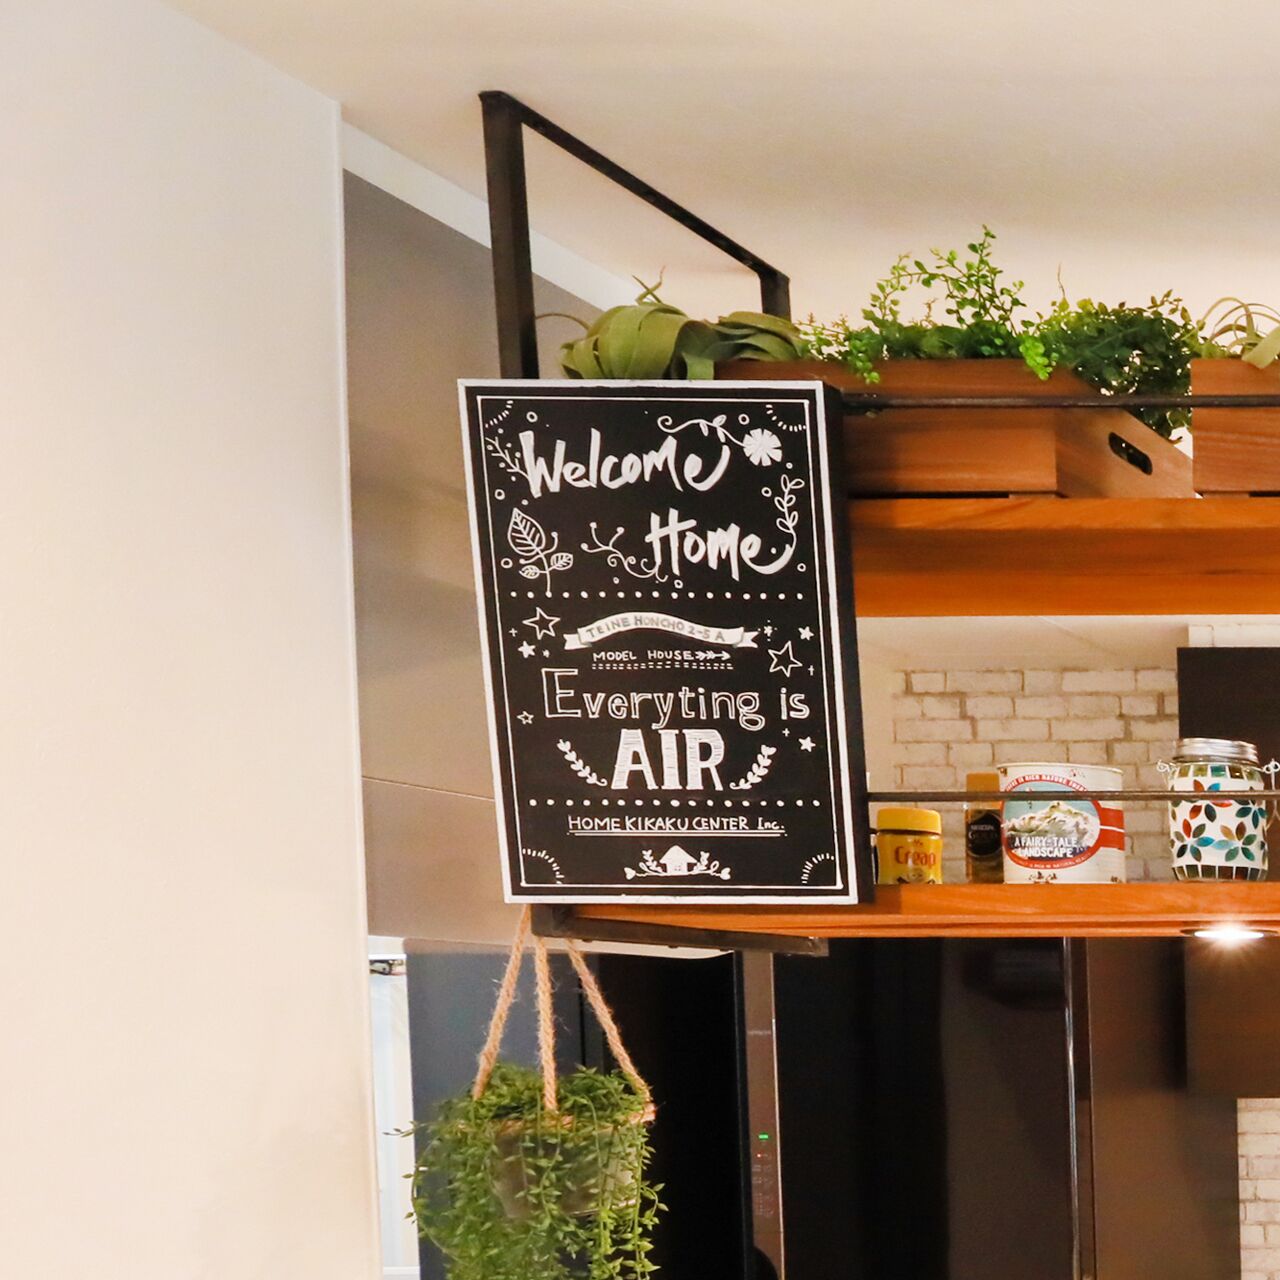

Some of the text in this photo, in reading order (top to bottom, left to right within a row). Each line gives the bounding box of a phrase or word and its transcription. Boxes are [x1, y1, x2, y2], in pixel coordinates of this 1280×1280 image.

[518, 426, 731, 499] Welcome
[645, 507, 790, 581] Home
[586, 617, 630, 638] TEINE
[634, 615, 685, 631] HONCHO
[592, 650, 695, 662] MODEL HOUSE
[541, 667, 811, 730] Everyting is
[610, 729, 725, 791] AIR
[567, 815, 785, 831] HOME KIKAKU CENTER Inc.
[895, 845, 936, 869] Creap
[1019, 846, 1074, 858] LANDSCAPE
